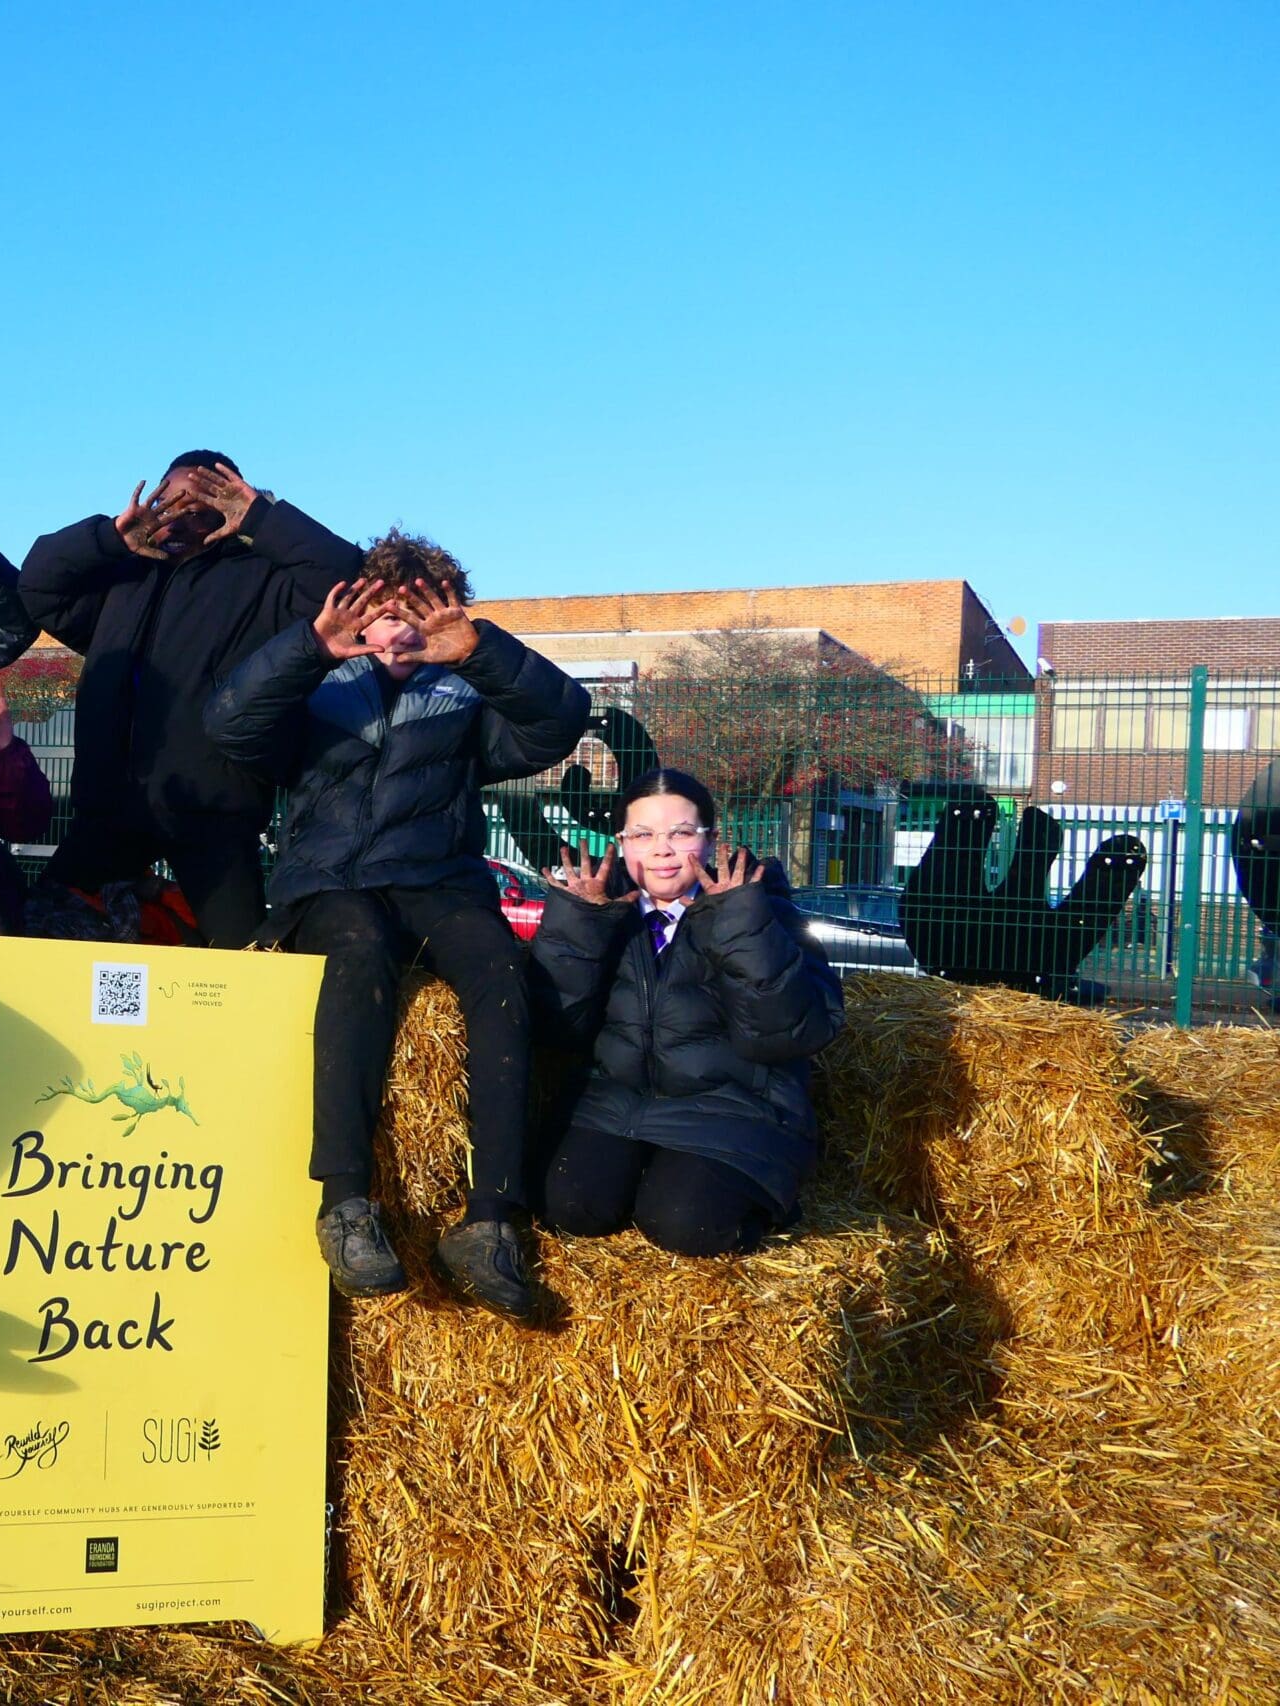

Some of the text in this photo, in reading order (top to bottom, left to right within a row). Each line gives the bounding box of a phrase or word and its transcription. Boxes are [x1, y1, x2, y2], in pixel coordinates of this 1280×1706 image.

[1164, 803, 1180, 818] P
[1, 1130, 224, 1224] Bringing
[3, 1209, 211, 1276] Nature
[27, 1290, 176, 1363] Back
[4, 1420, 50, 1458] Rewild
[44, 1507, 96, 1516] COMMUNITY
[141, 1504, 194, 1512] GENEROUSLY
[196, 1502, 243, 1510] SUPPORTED
[90, 1543, 114, 1553] ERANDA
[136, 1598, 221, 1611] sugiproject.com
